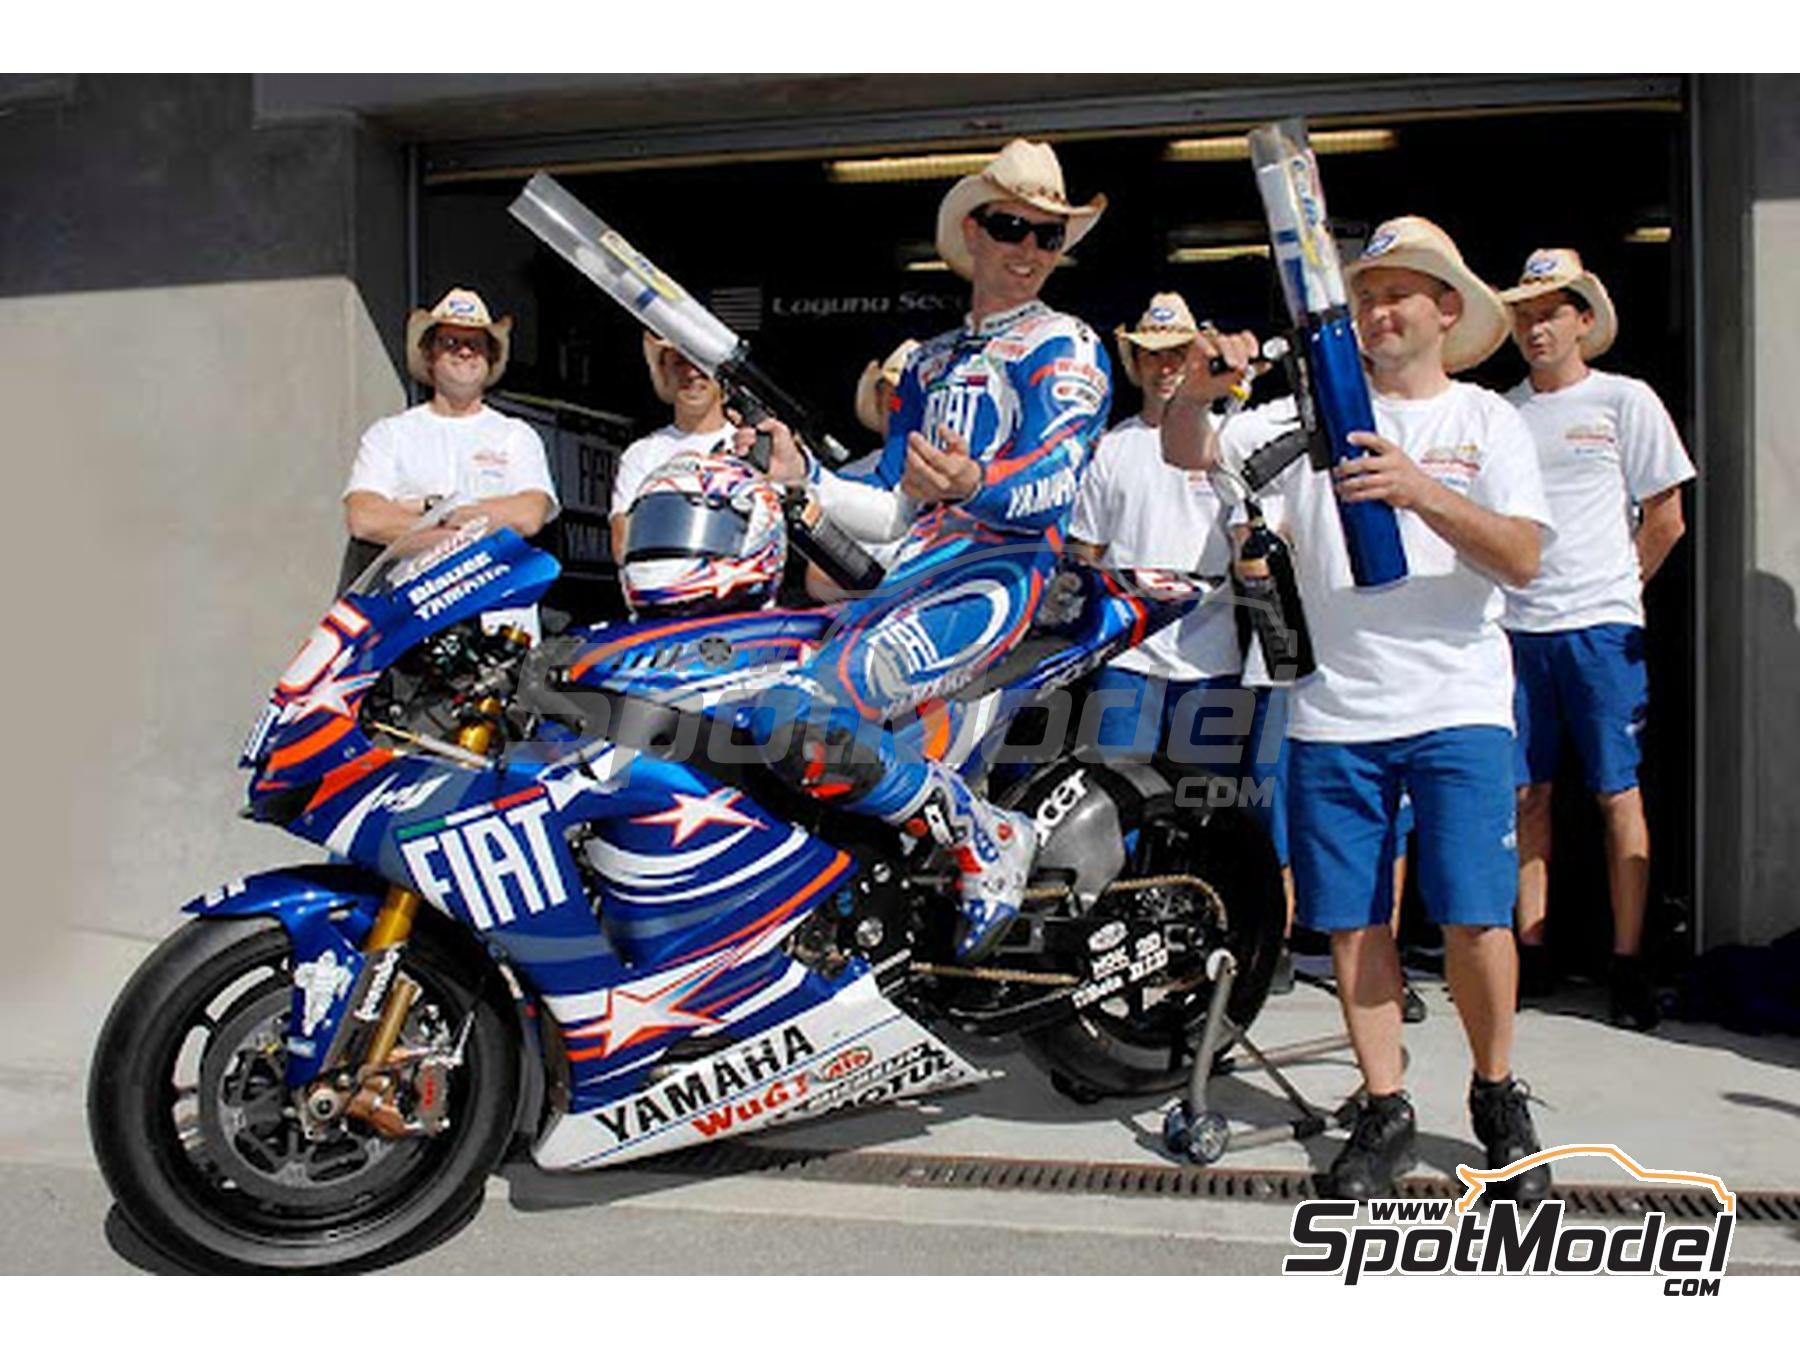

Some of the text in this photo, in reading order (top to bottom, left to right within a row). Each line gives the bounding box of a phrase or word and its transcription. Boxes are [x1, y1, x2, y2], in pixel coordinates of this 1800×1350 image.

[772, 297, 892, 319] Laguna
[401, 800, 567, 931] FIAT
[593, 1025, 814, 1143] YAMAHA
